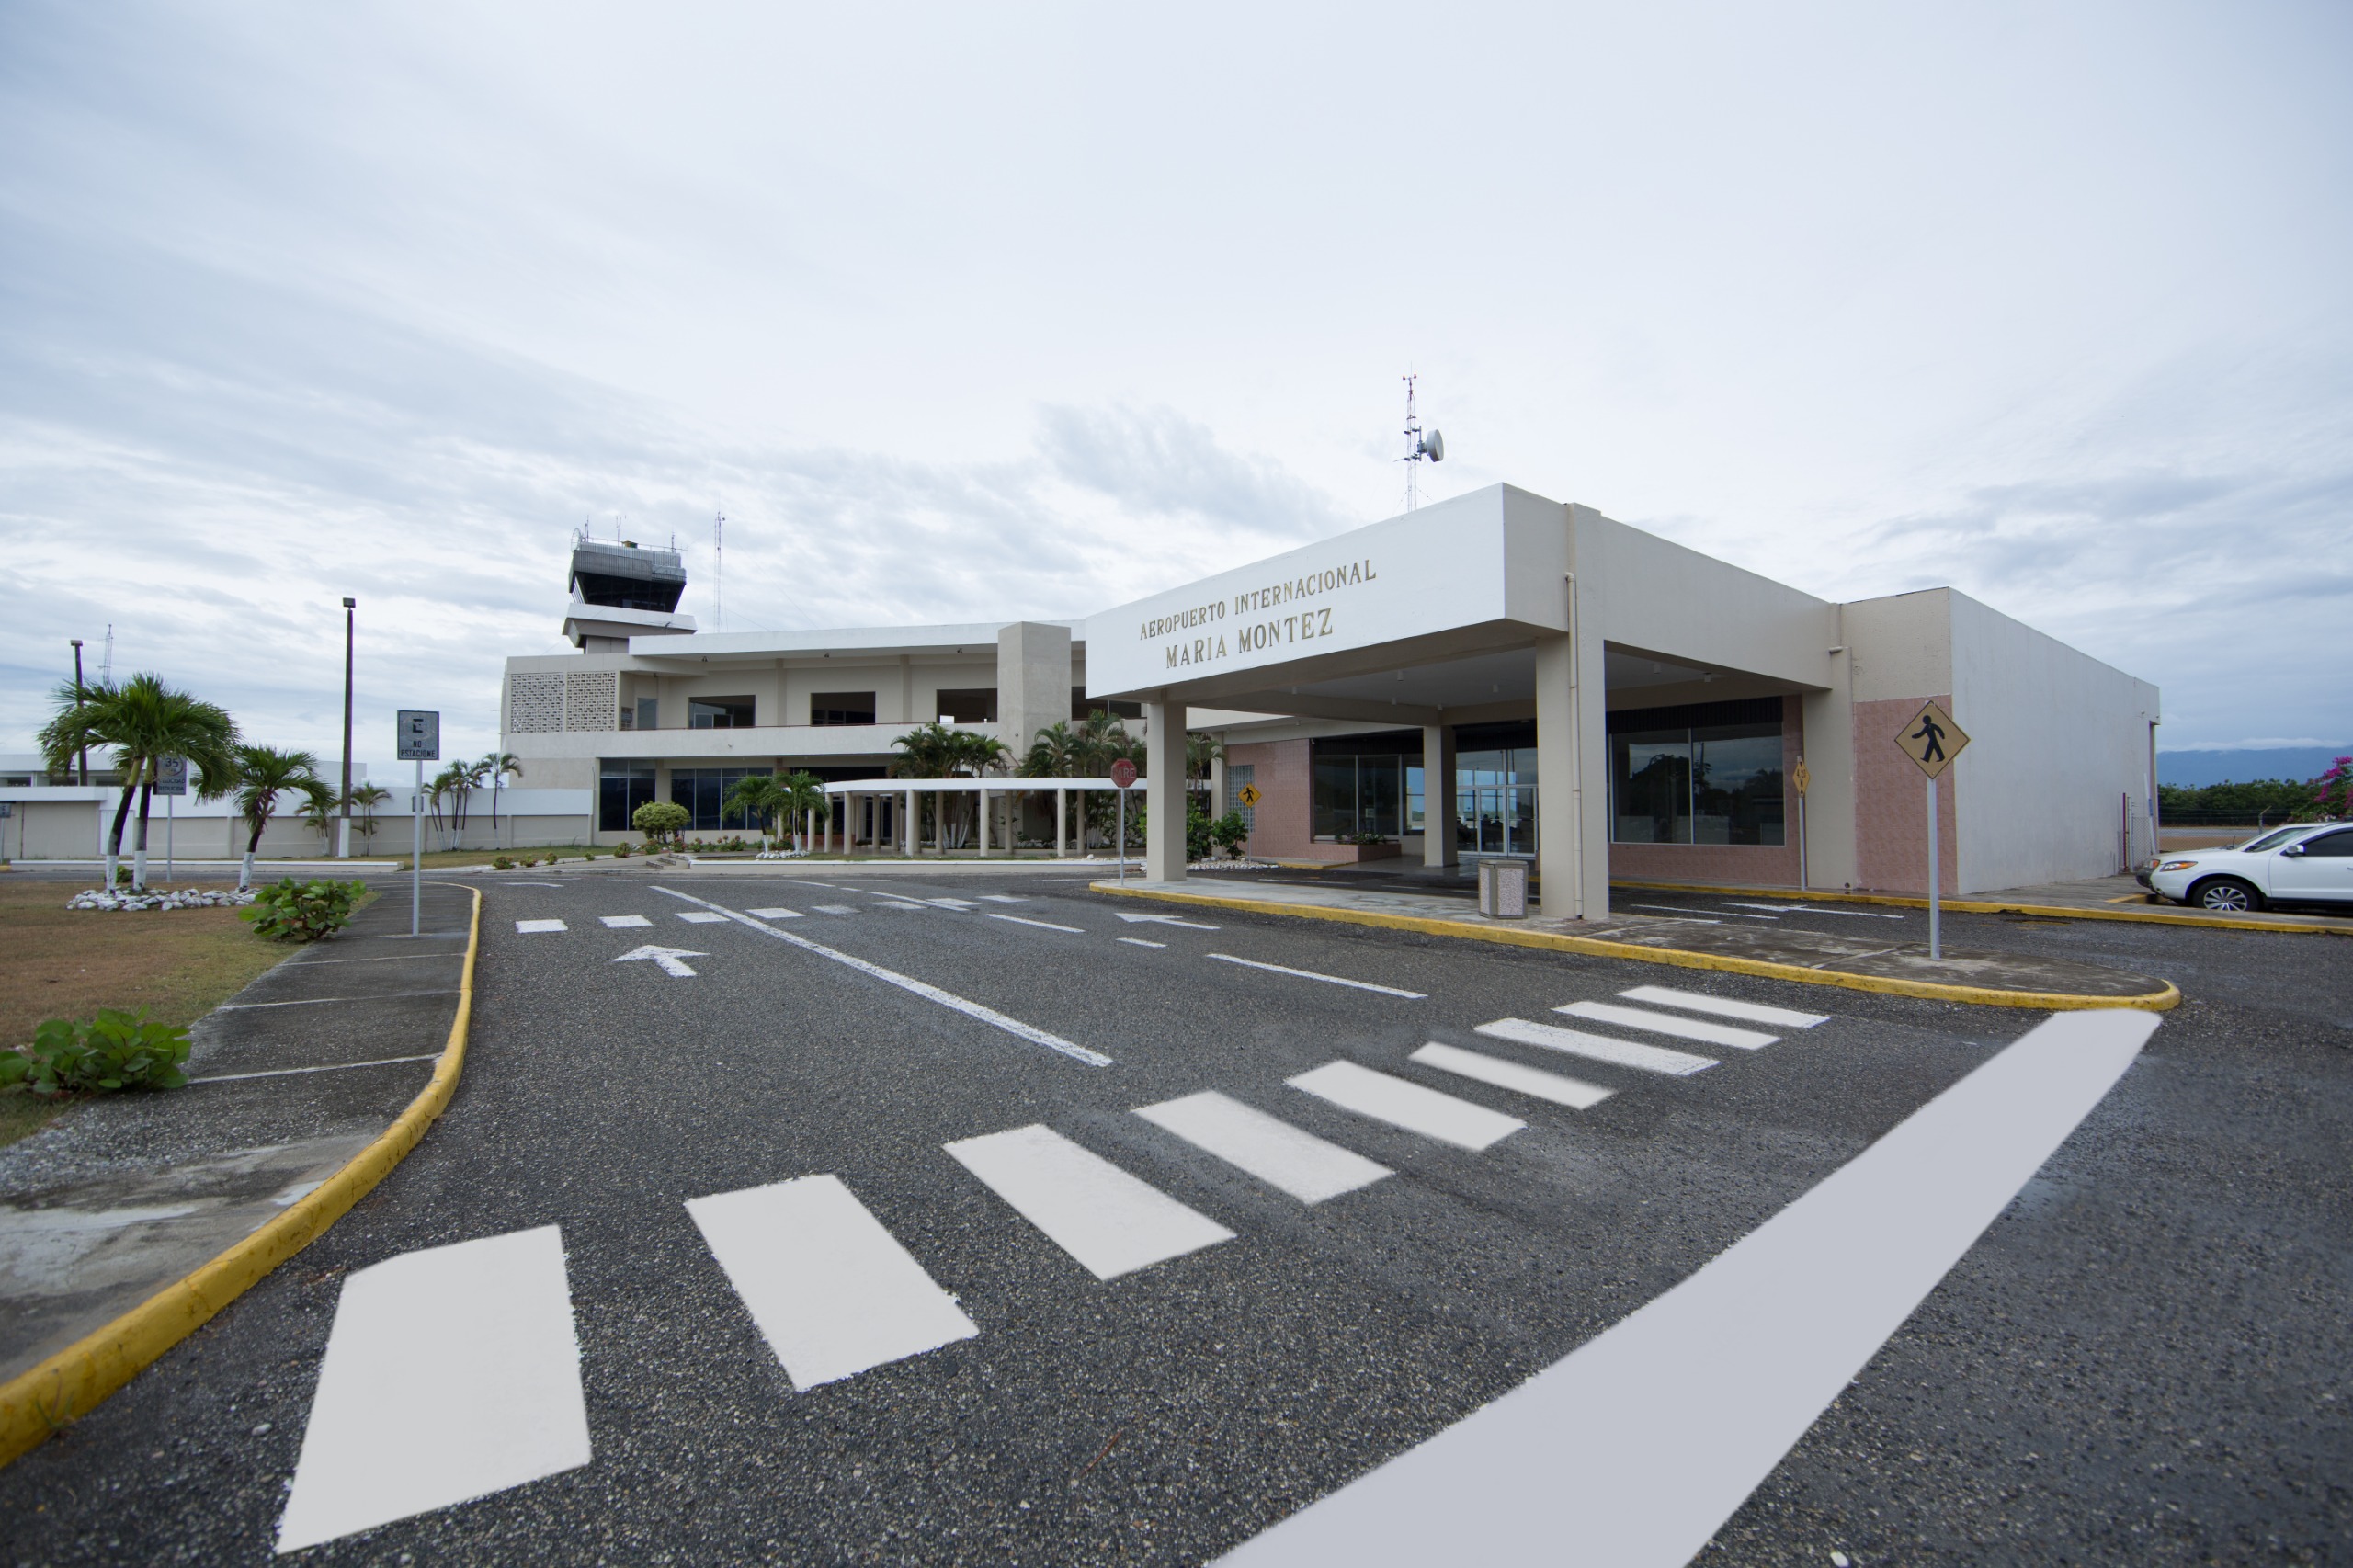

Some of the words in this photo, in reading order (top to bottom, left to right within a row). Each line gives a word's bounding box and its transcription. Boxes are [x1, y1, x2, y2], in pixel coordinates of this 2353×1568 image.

[1140, 600, 1225, 641] AEROPUERTO
[1234, 559, 1377, 615] INTERNACIONAL
[1165, 634, 1227, 669] MARIA
[1238, 608, 1333, 653] MONTEZ
[413, 740, 422, 748] NO
[401, 749, 436, 757] ESTACIONE
[165, 757, 179, 767] 35
